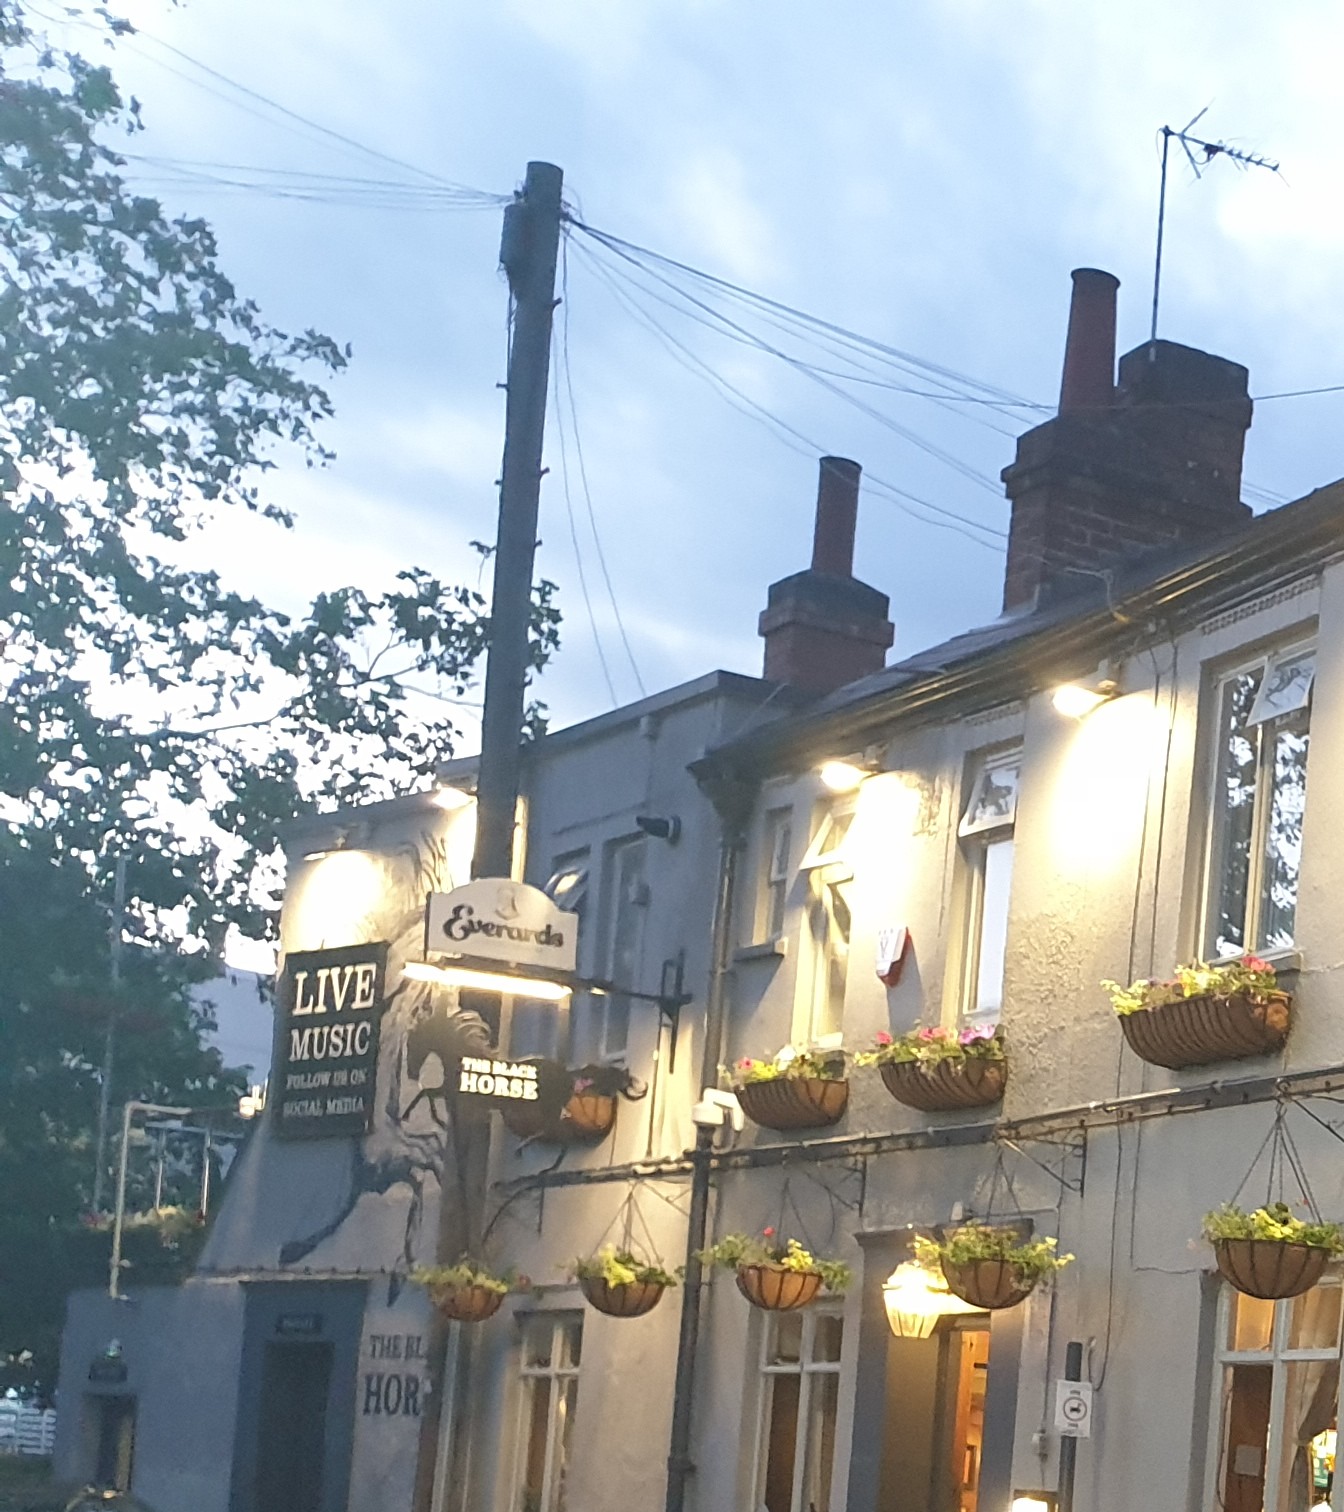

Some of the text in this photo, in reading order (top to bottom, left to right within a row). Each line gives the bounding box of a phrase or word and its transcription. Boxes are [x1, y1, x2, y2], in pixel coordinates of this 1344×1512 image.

[443, 903, 564, 948] Everards
[291, 962, 377, 1016] LIVE
[288, 1020, 371, 1063] MUSIC
[286, 1071, 331, 1090] FOLLOW
[462, 1056, 537, 1080] THE BLACK
[459, 1072, 539, 1101] HORSE
[282, 1096, 365, 1118] SOCIAL MEDIA
[370, 1334, 402, 1360] THE
[363, 1373, 423, 1416] HOR
